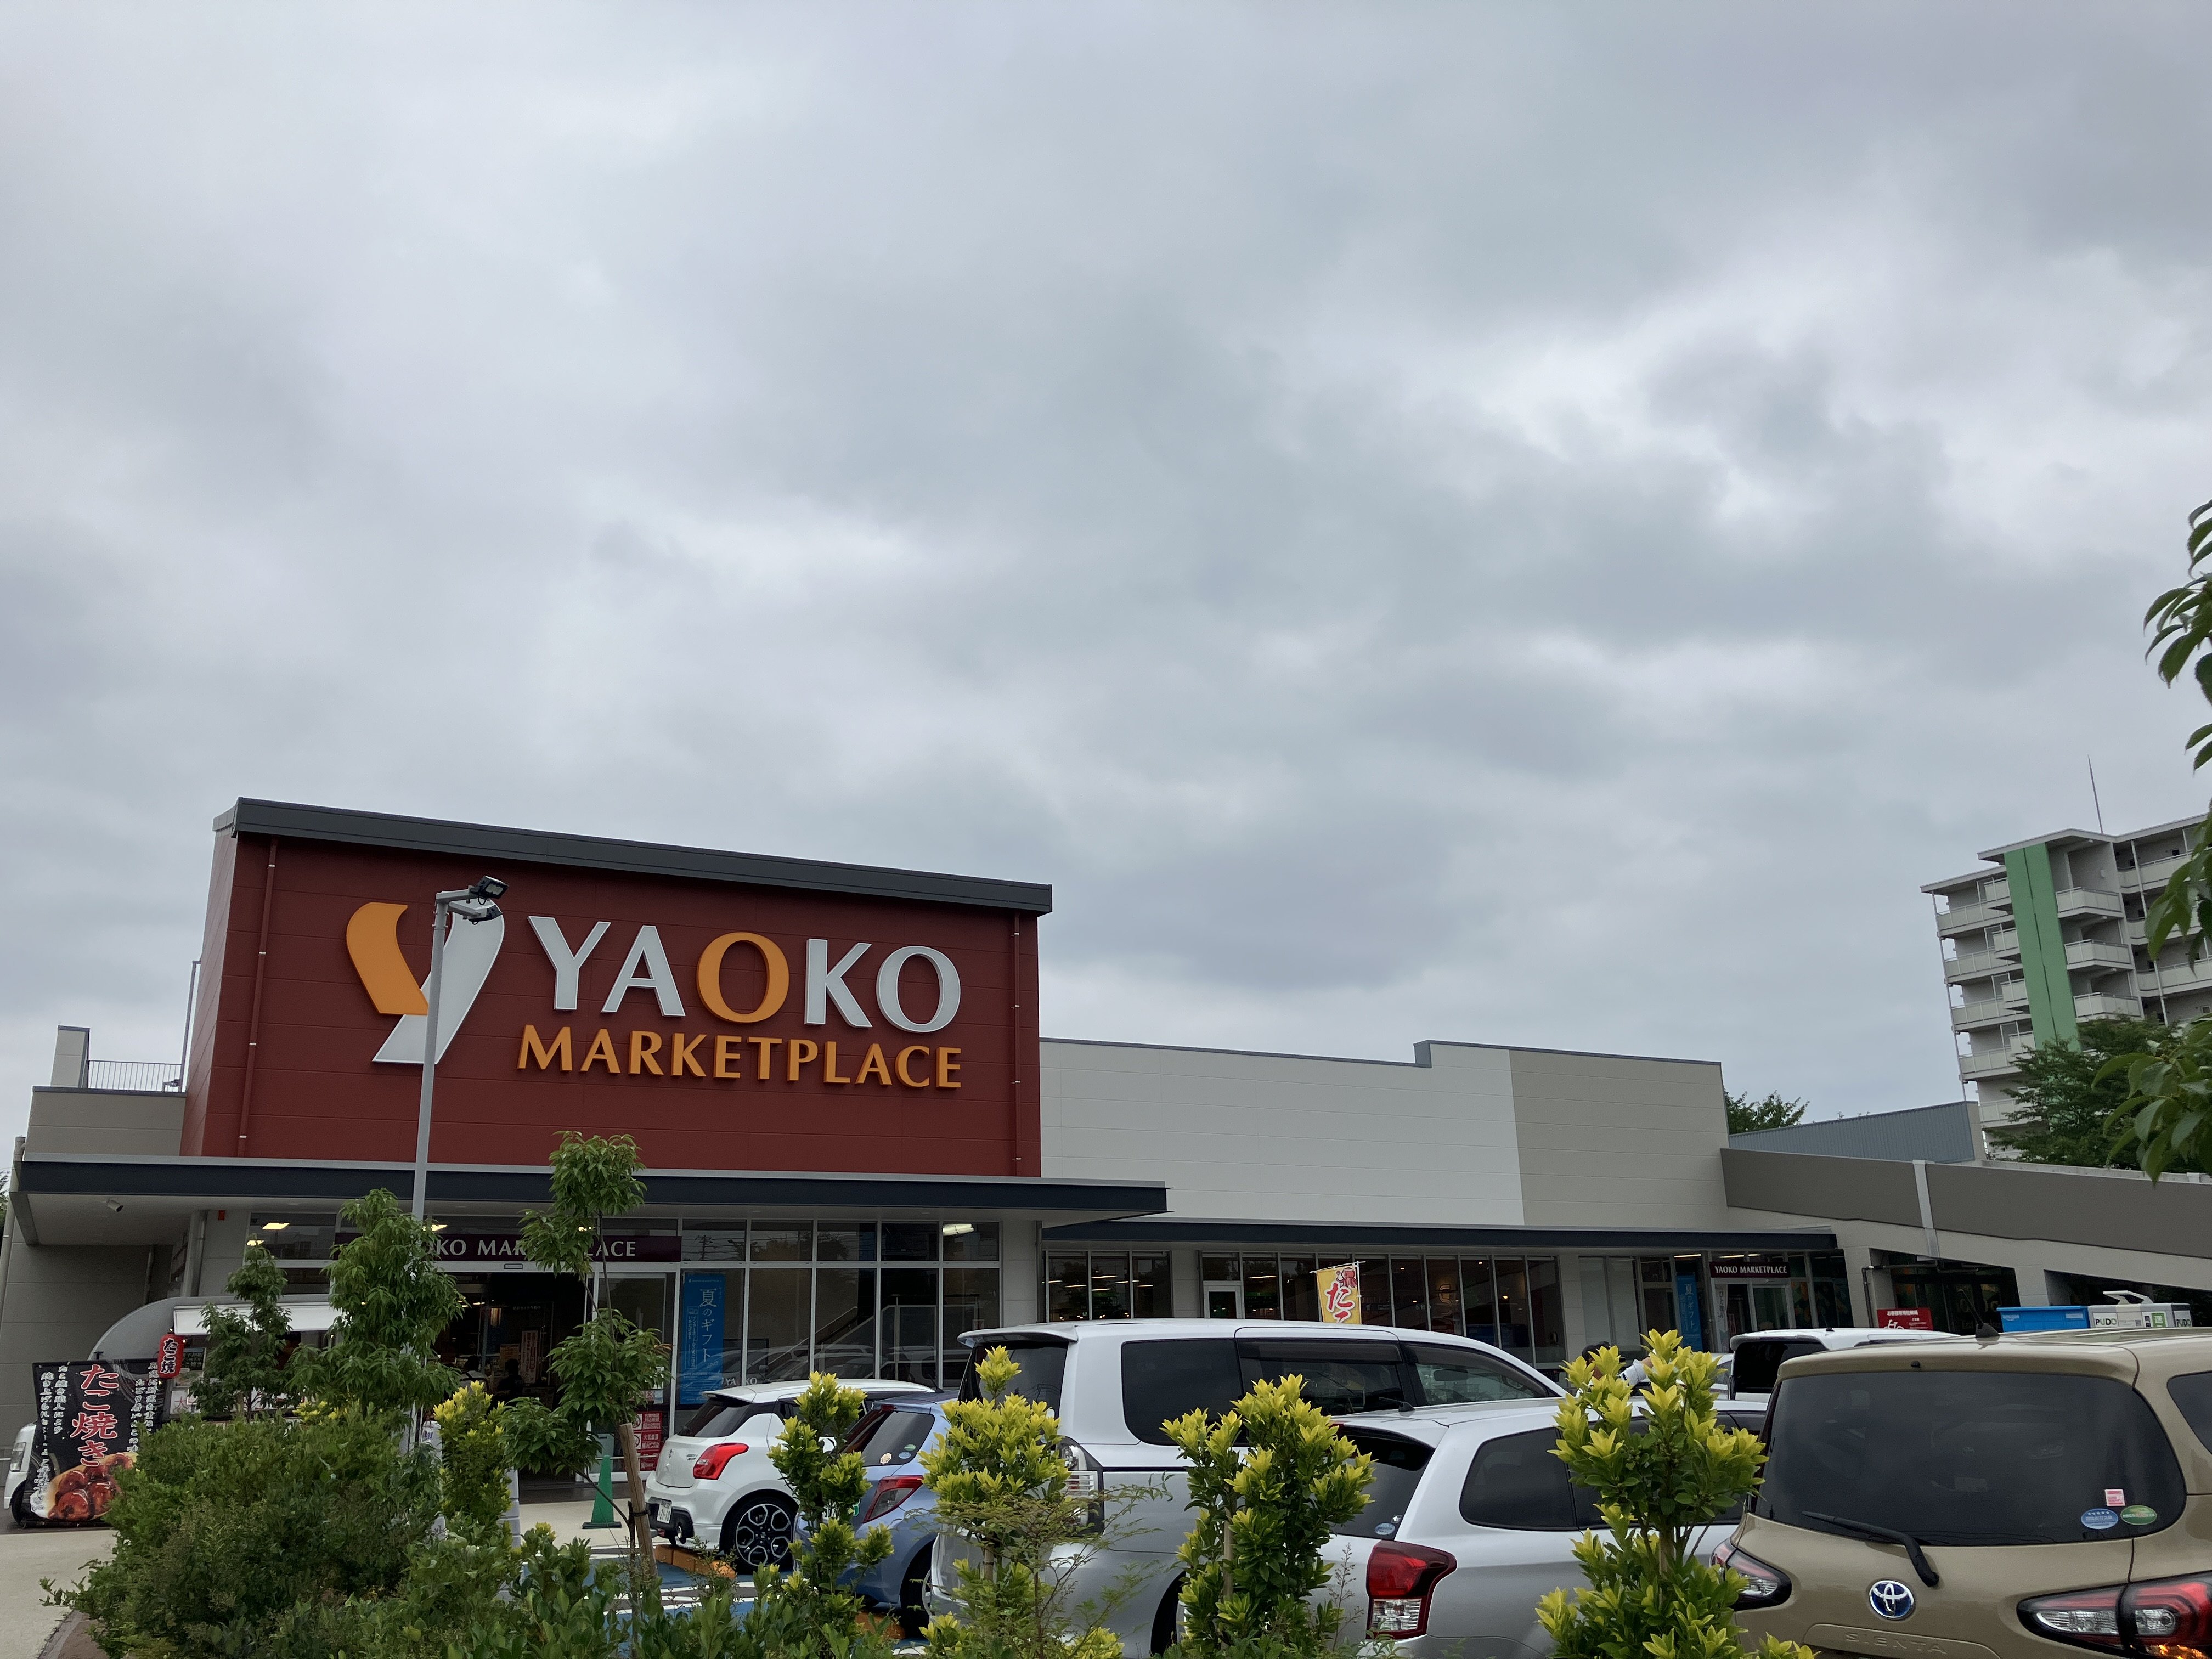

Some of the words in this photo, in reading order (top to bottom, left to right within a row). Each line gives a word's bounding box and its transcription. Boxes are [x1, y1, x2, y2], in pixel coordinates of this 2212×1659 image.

[528, 915, 961, 1034] YAOKO
[517, 1024, 961, 1088] MARKETPLACE
[699, 1288, 718, 1363] 夏のギフト
[2176, 1318, 2191, 1327] PUDO
[160, 1337, 179, 1375] たこ焼
[70, 1364, 119, 1467] たこ焼き
[1845, 1632, 1948, 1654] SIENTA
